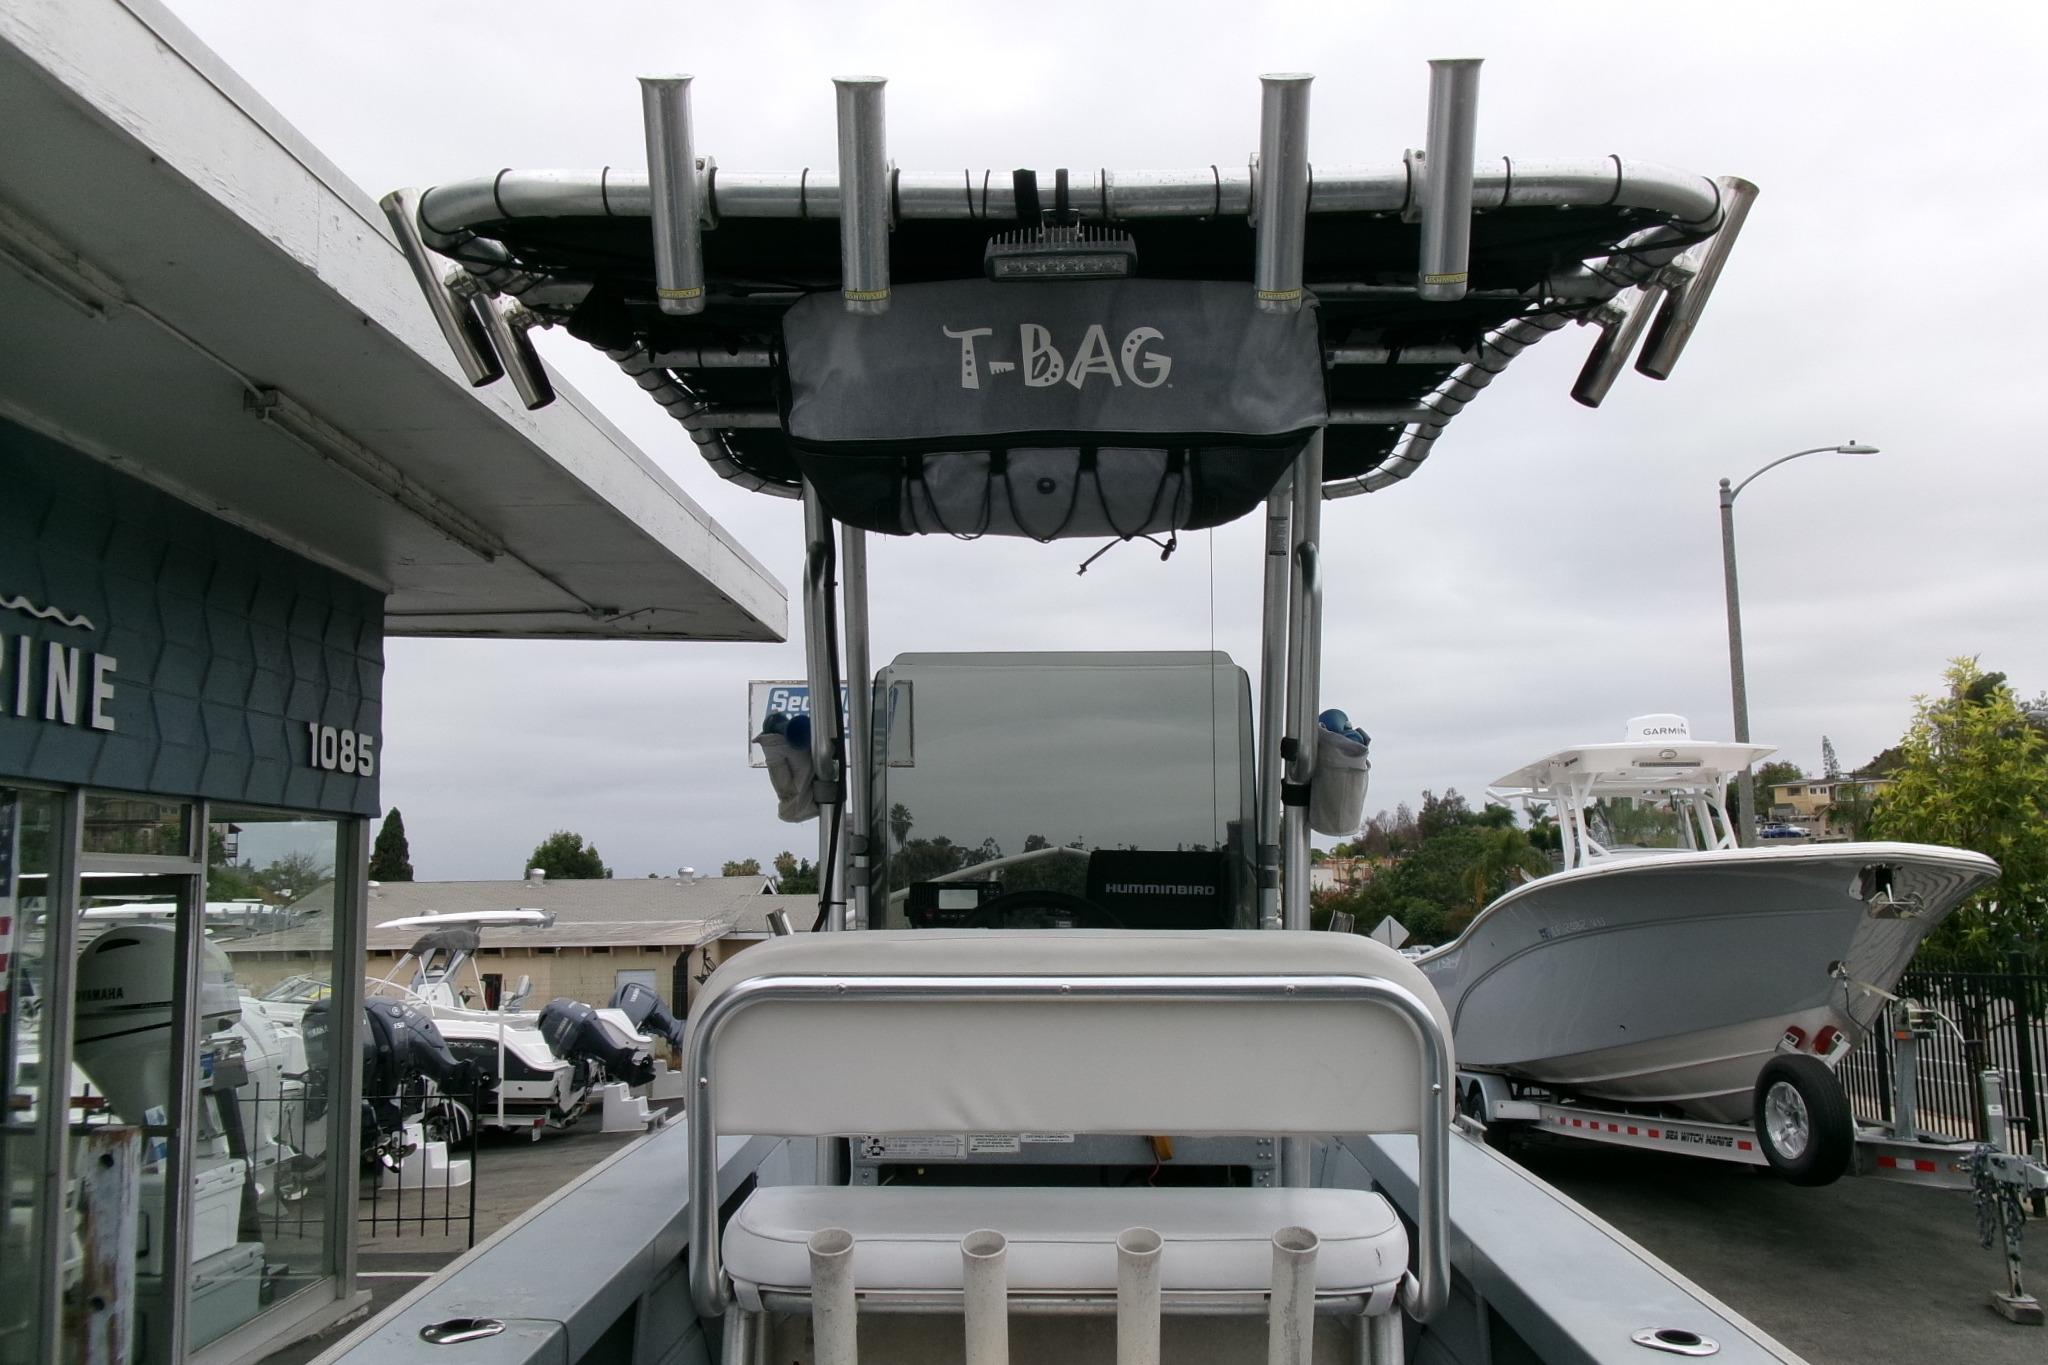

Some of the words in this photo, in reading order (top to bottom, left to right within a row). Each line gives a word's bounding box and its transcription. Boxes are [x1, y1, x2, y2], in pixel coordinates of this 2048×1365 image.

[943, 324, 1173, 390] T-BAG
[0, 633, 117, 731] INE
[308, 722, 374, 777] 1085
[1643, 727, 1687, 736] GARMIN
[1105, 883, 1216, 896] HUMMINBIRD
[1665, 1129, 1679, 1140] SEA
[1681, 1131, 1704, 1144] WITCH
[1705, 1134, 1734, 1148] MARINE
